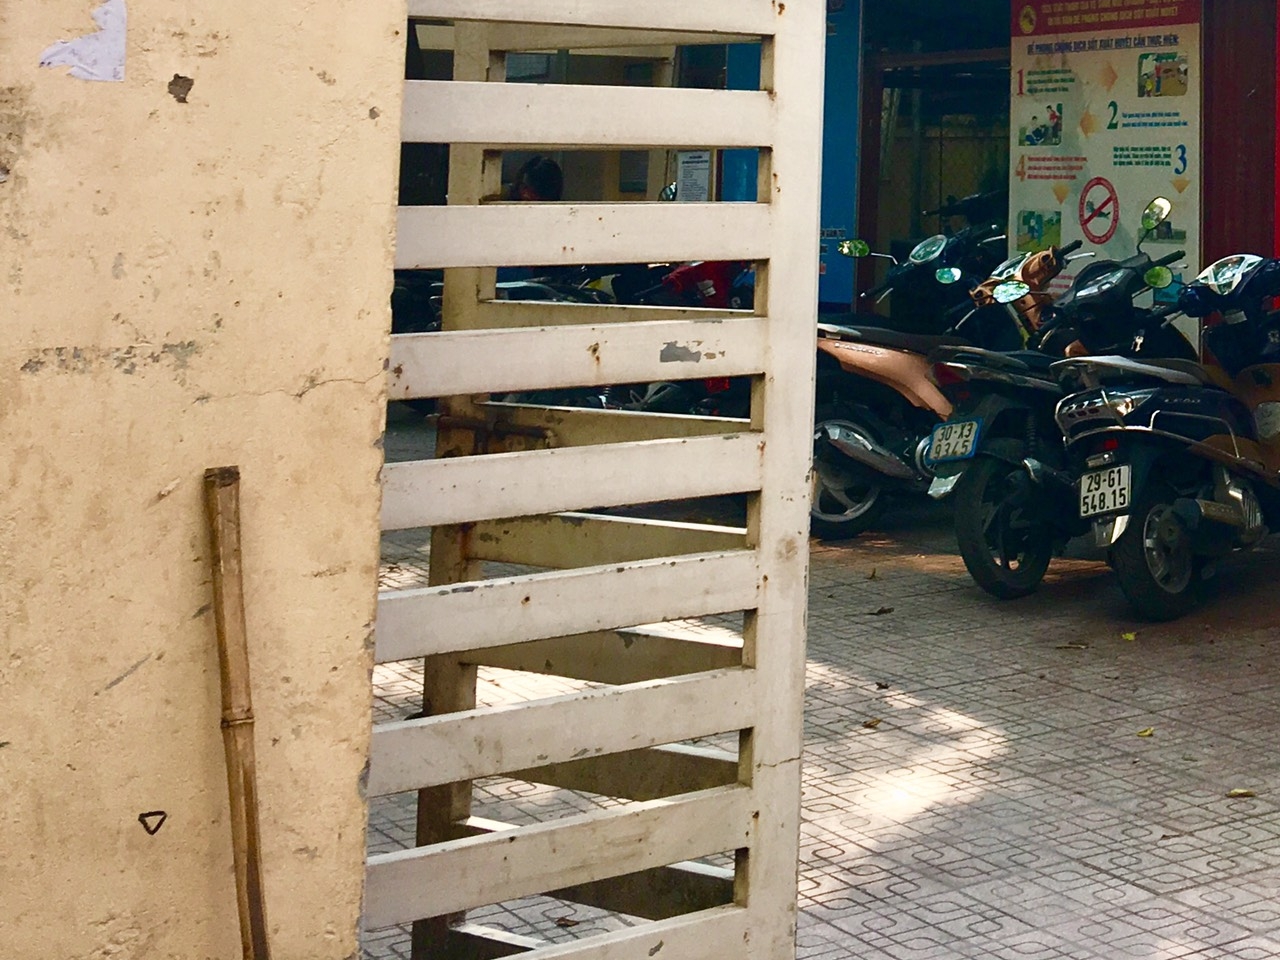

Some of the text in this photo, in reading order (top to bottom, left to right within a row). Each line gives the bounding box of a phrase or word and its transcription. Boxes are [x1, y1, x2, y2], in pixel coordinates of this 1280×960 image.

[1017, 69, 1024, 96] 1
[1106, 101, 1119, 130] 2
[1015, 155, 1026, 182] 4
[1174, 144, 1188, 175] 3
[1087, 468, 1122, 493] 29-G1
[1082, 488, 1126, 514] 548.15
